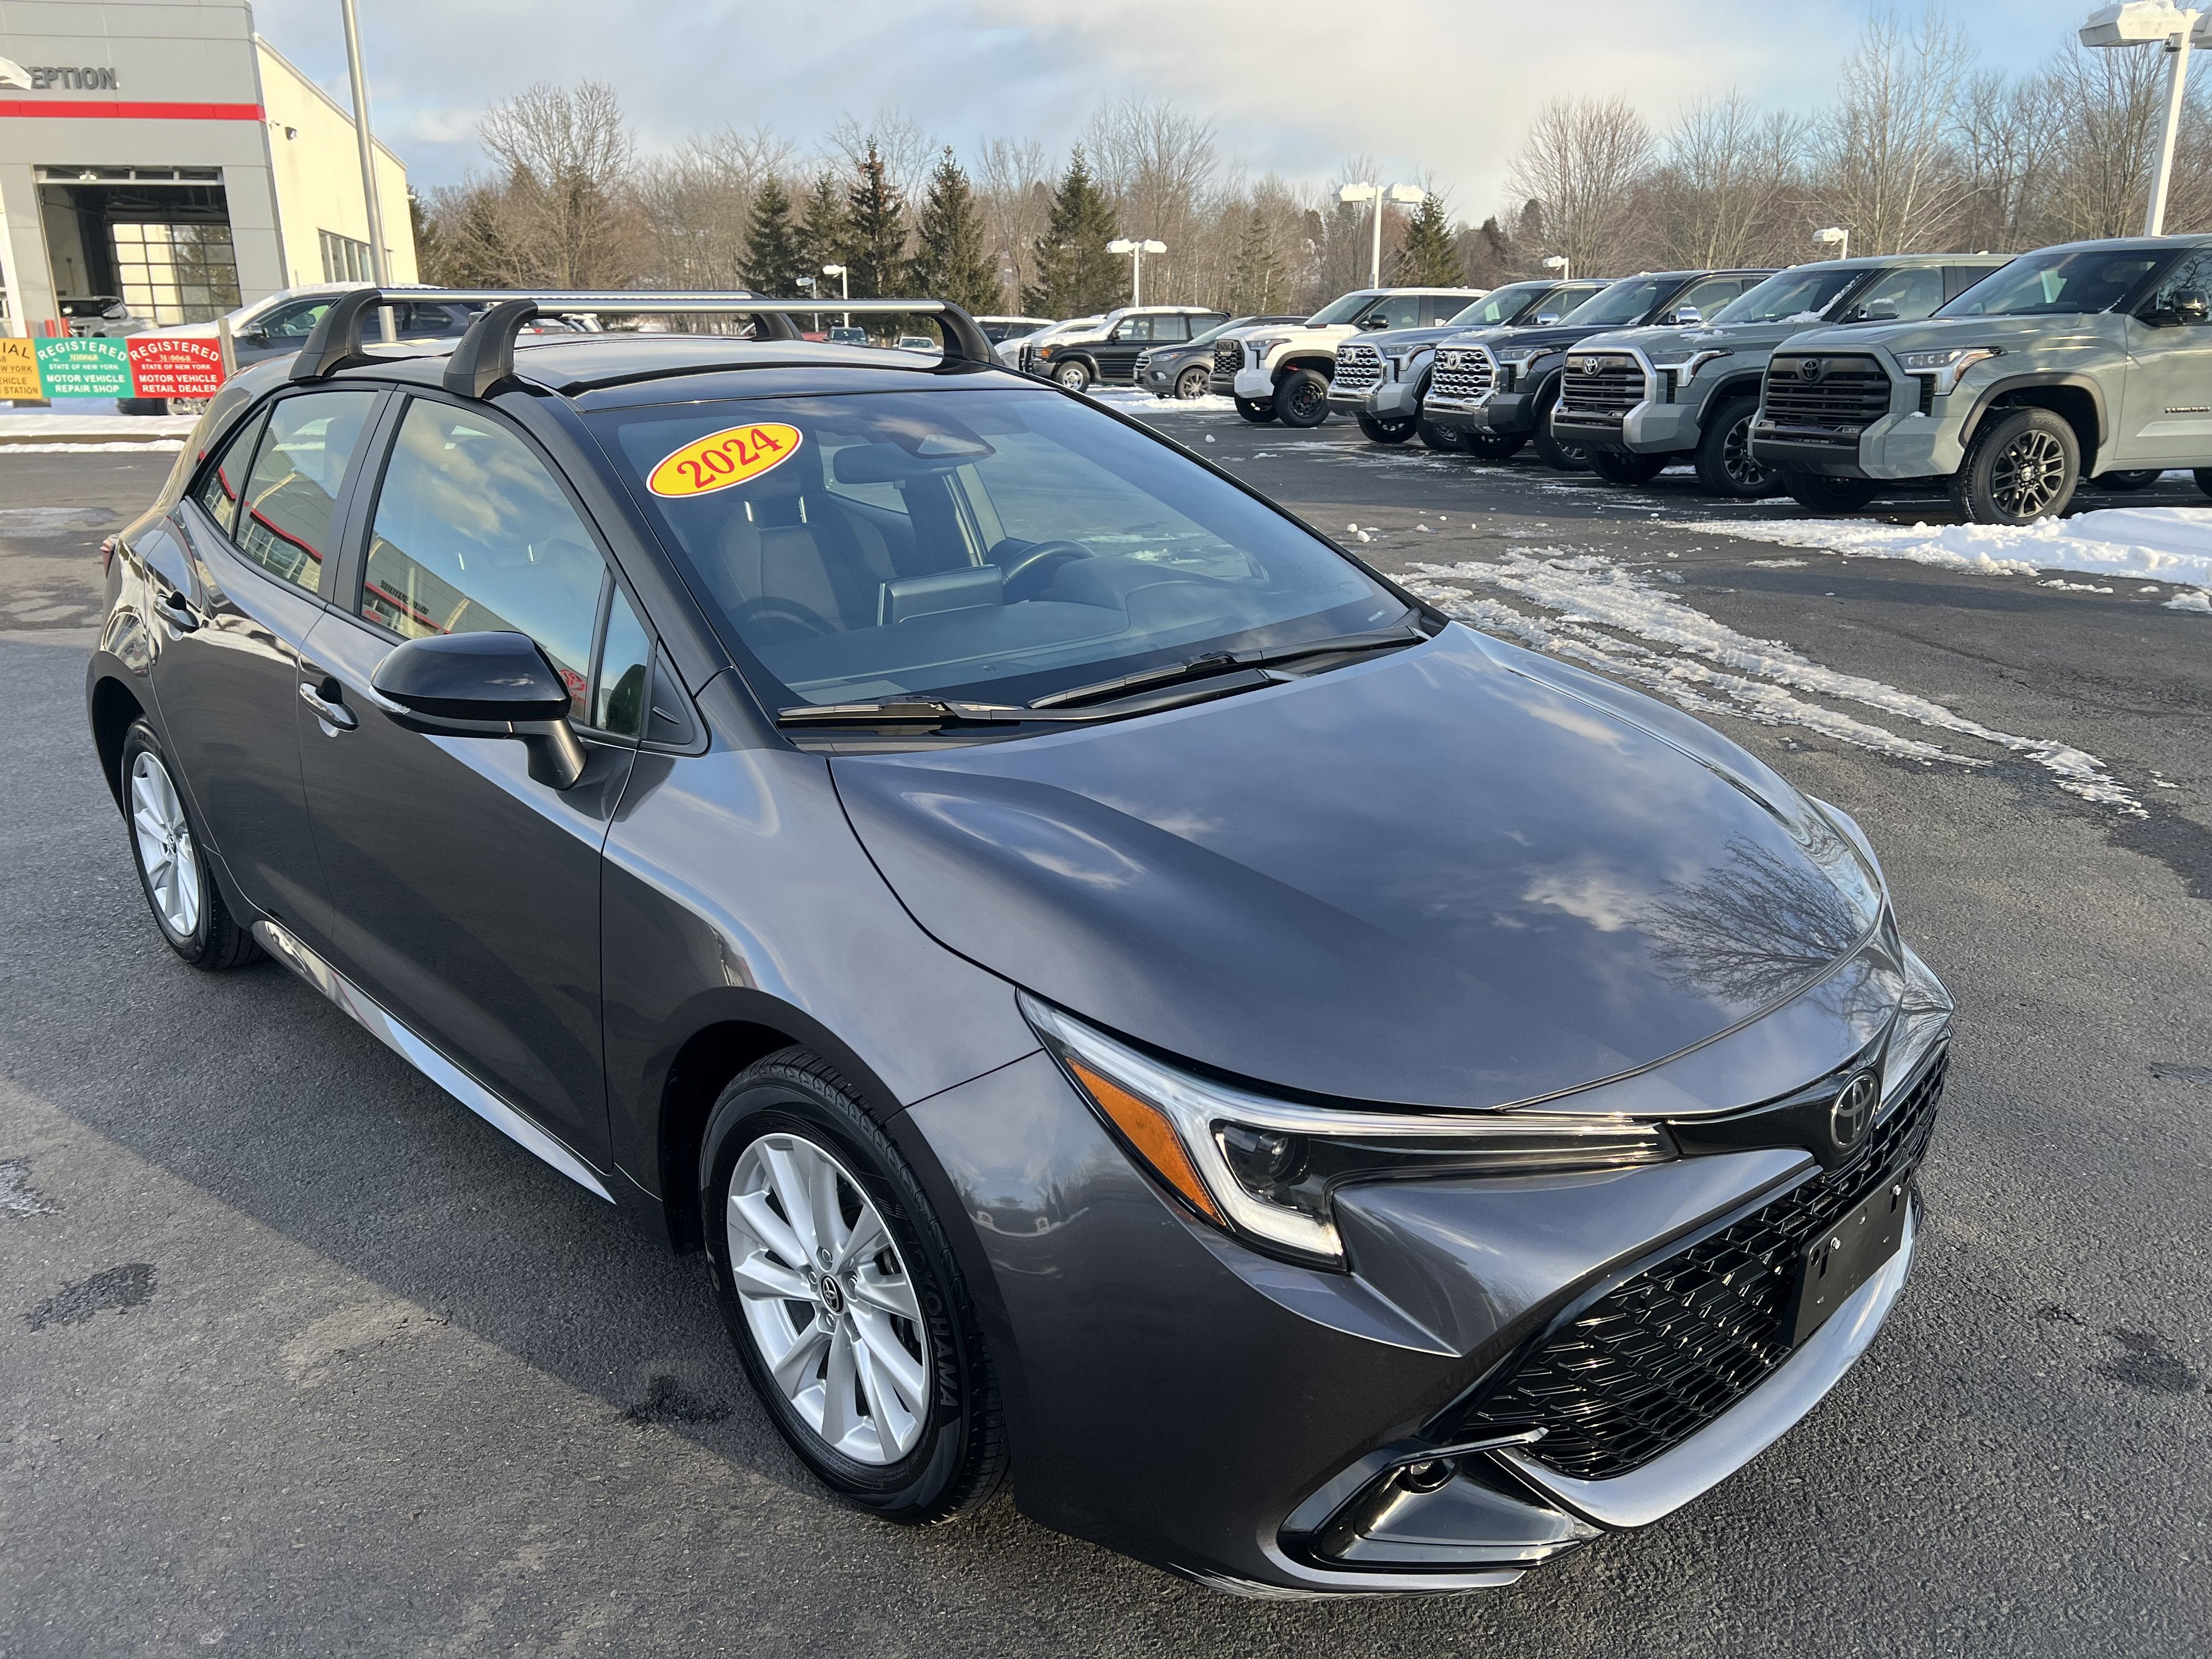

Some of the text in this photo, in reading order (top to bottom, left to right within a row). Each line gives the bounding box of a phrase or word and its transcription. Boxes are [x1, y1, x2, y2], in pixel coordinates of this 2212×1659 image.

[20, 66, 117, 89] EPTION
[37, 341, 126, 362] REGISTERED
[129, 341, 218, 362] REGISTERED
[46, 374, 125, 383] MOTOR VEHICLE
[139, 374, 217, 383] MOTOR VEHICLE
[55, 385, 91, 393] REPAIR
[142, 385, 217, 393] RETAIL DEALER
[677, 428, 783, 488] 2024
